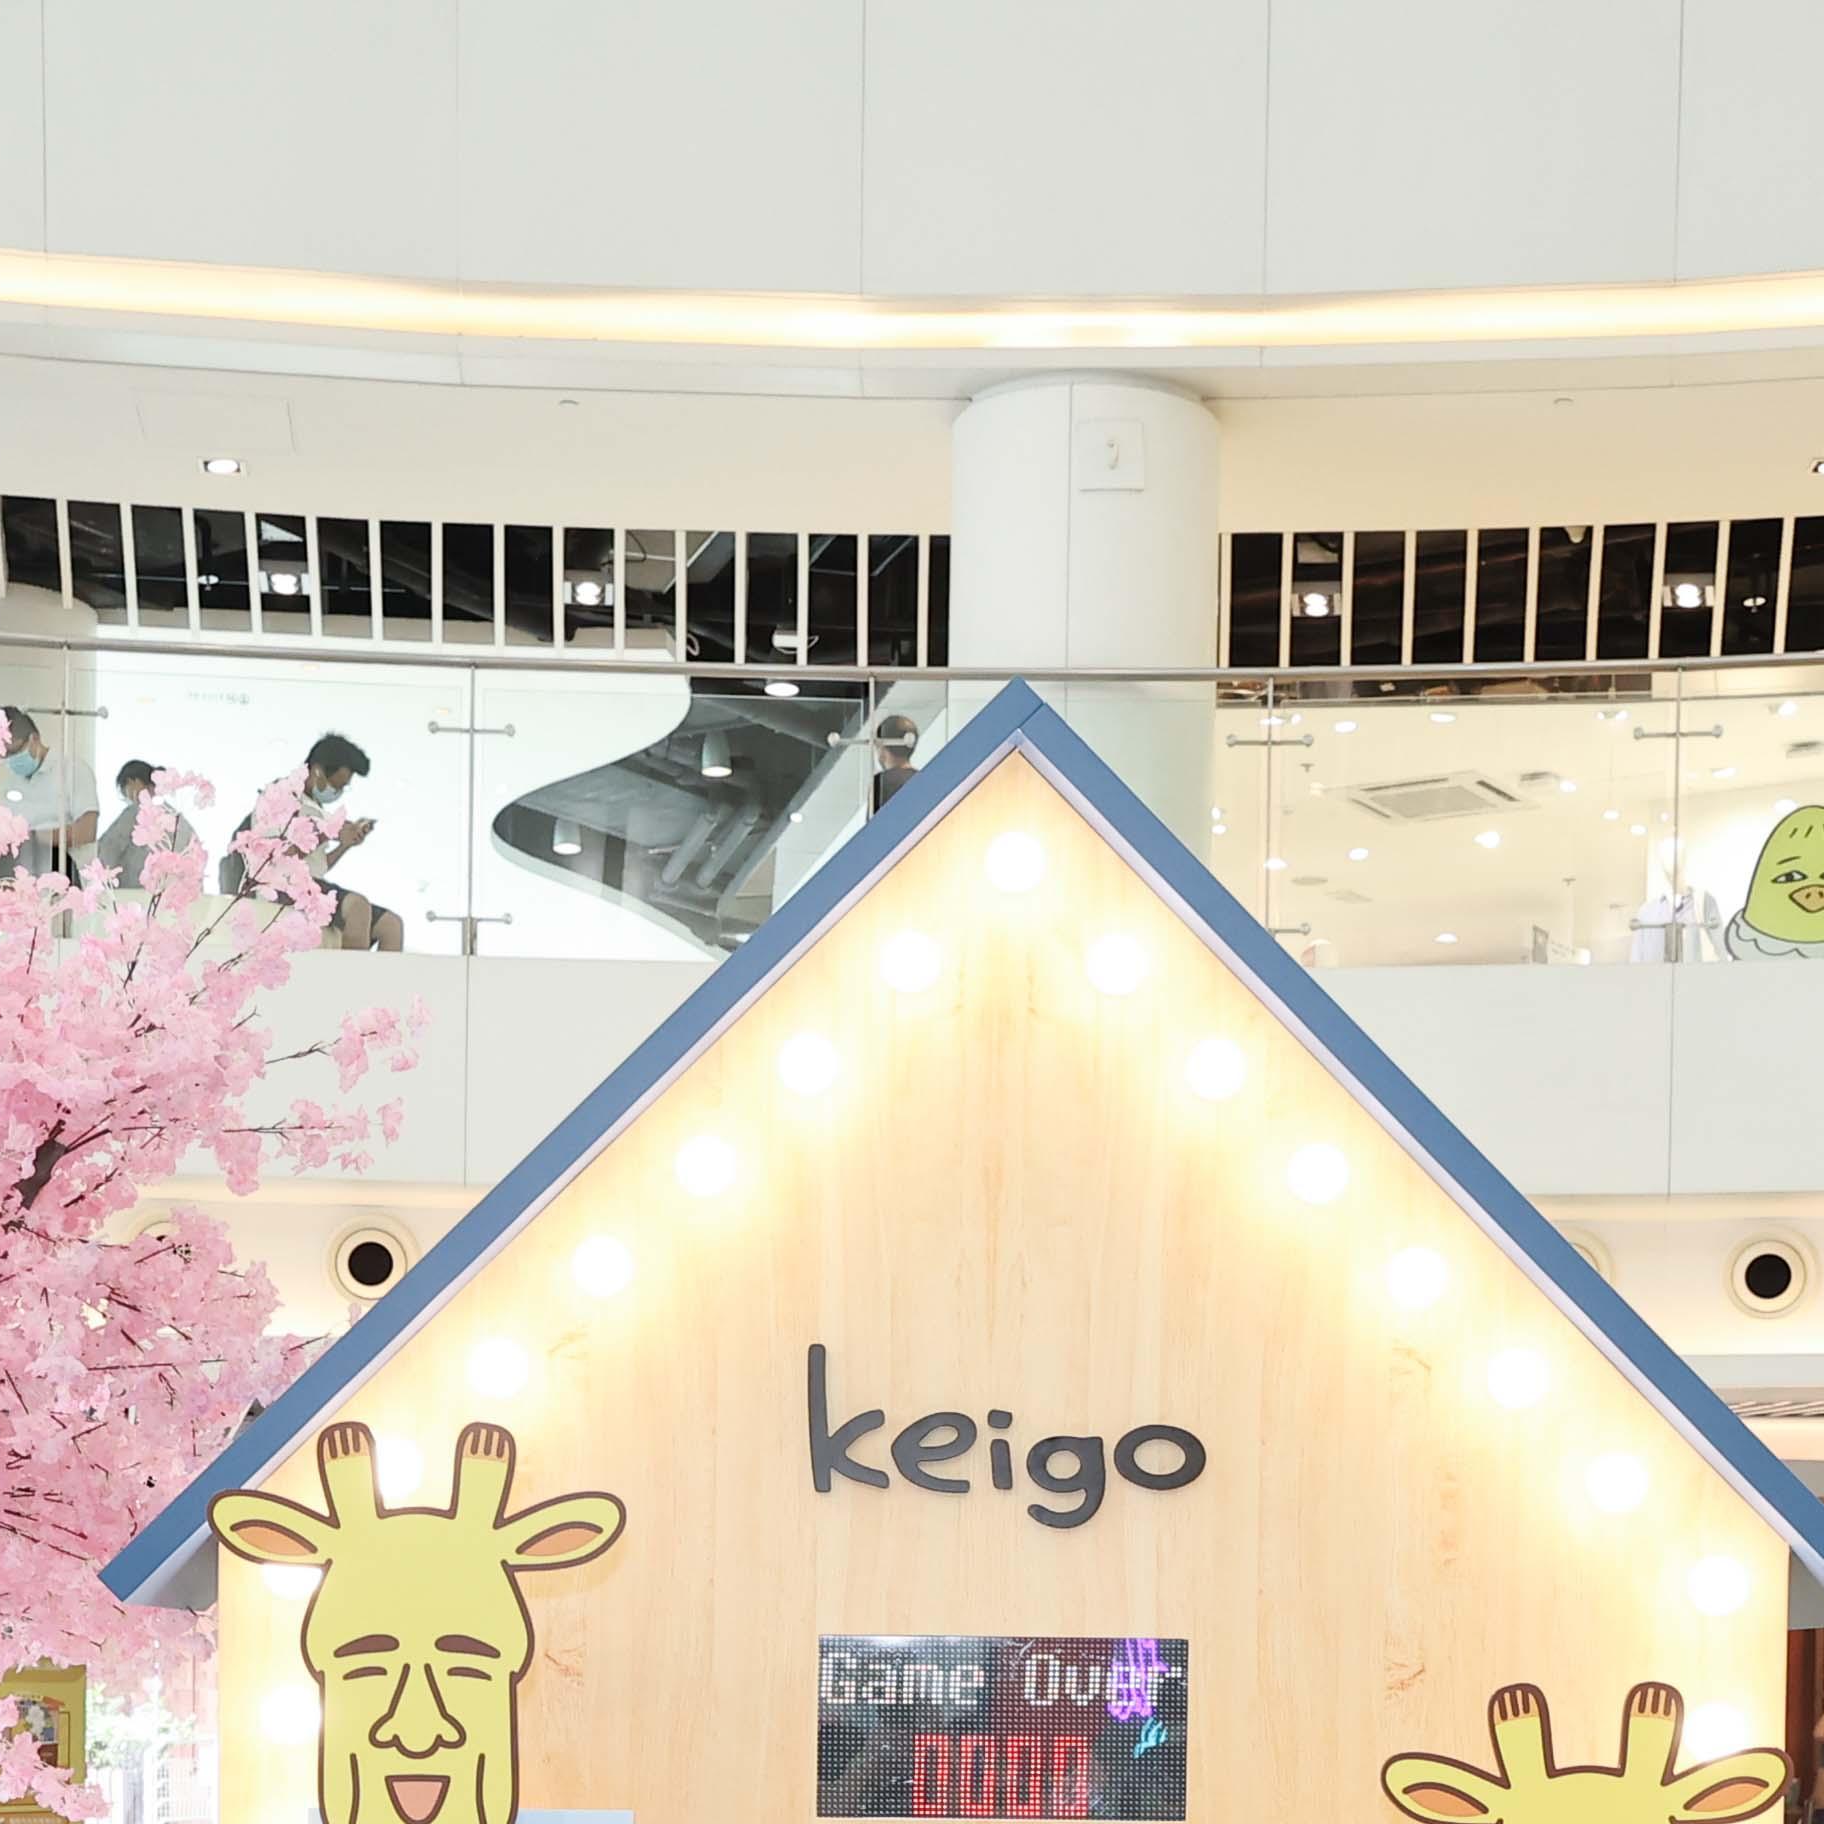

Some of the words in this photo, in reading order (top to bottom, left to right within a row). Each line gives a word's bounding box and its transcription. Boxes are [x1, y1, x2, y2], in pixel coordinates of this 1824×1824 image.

[806, 1343, 1207, 1529] keigo
[819, 1651, 985, 1706] Game
[1023, 1653, 1183, 1708] Over
[911, 1733, 1089, 1817] 0000
